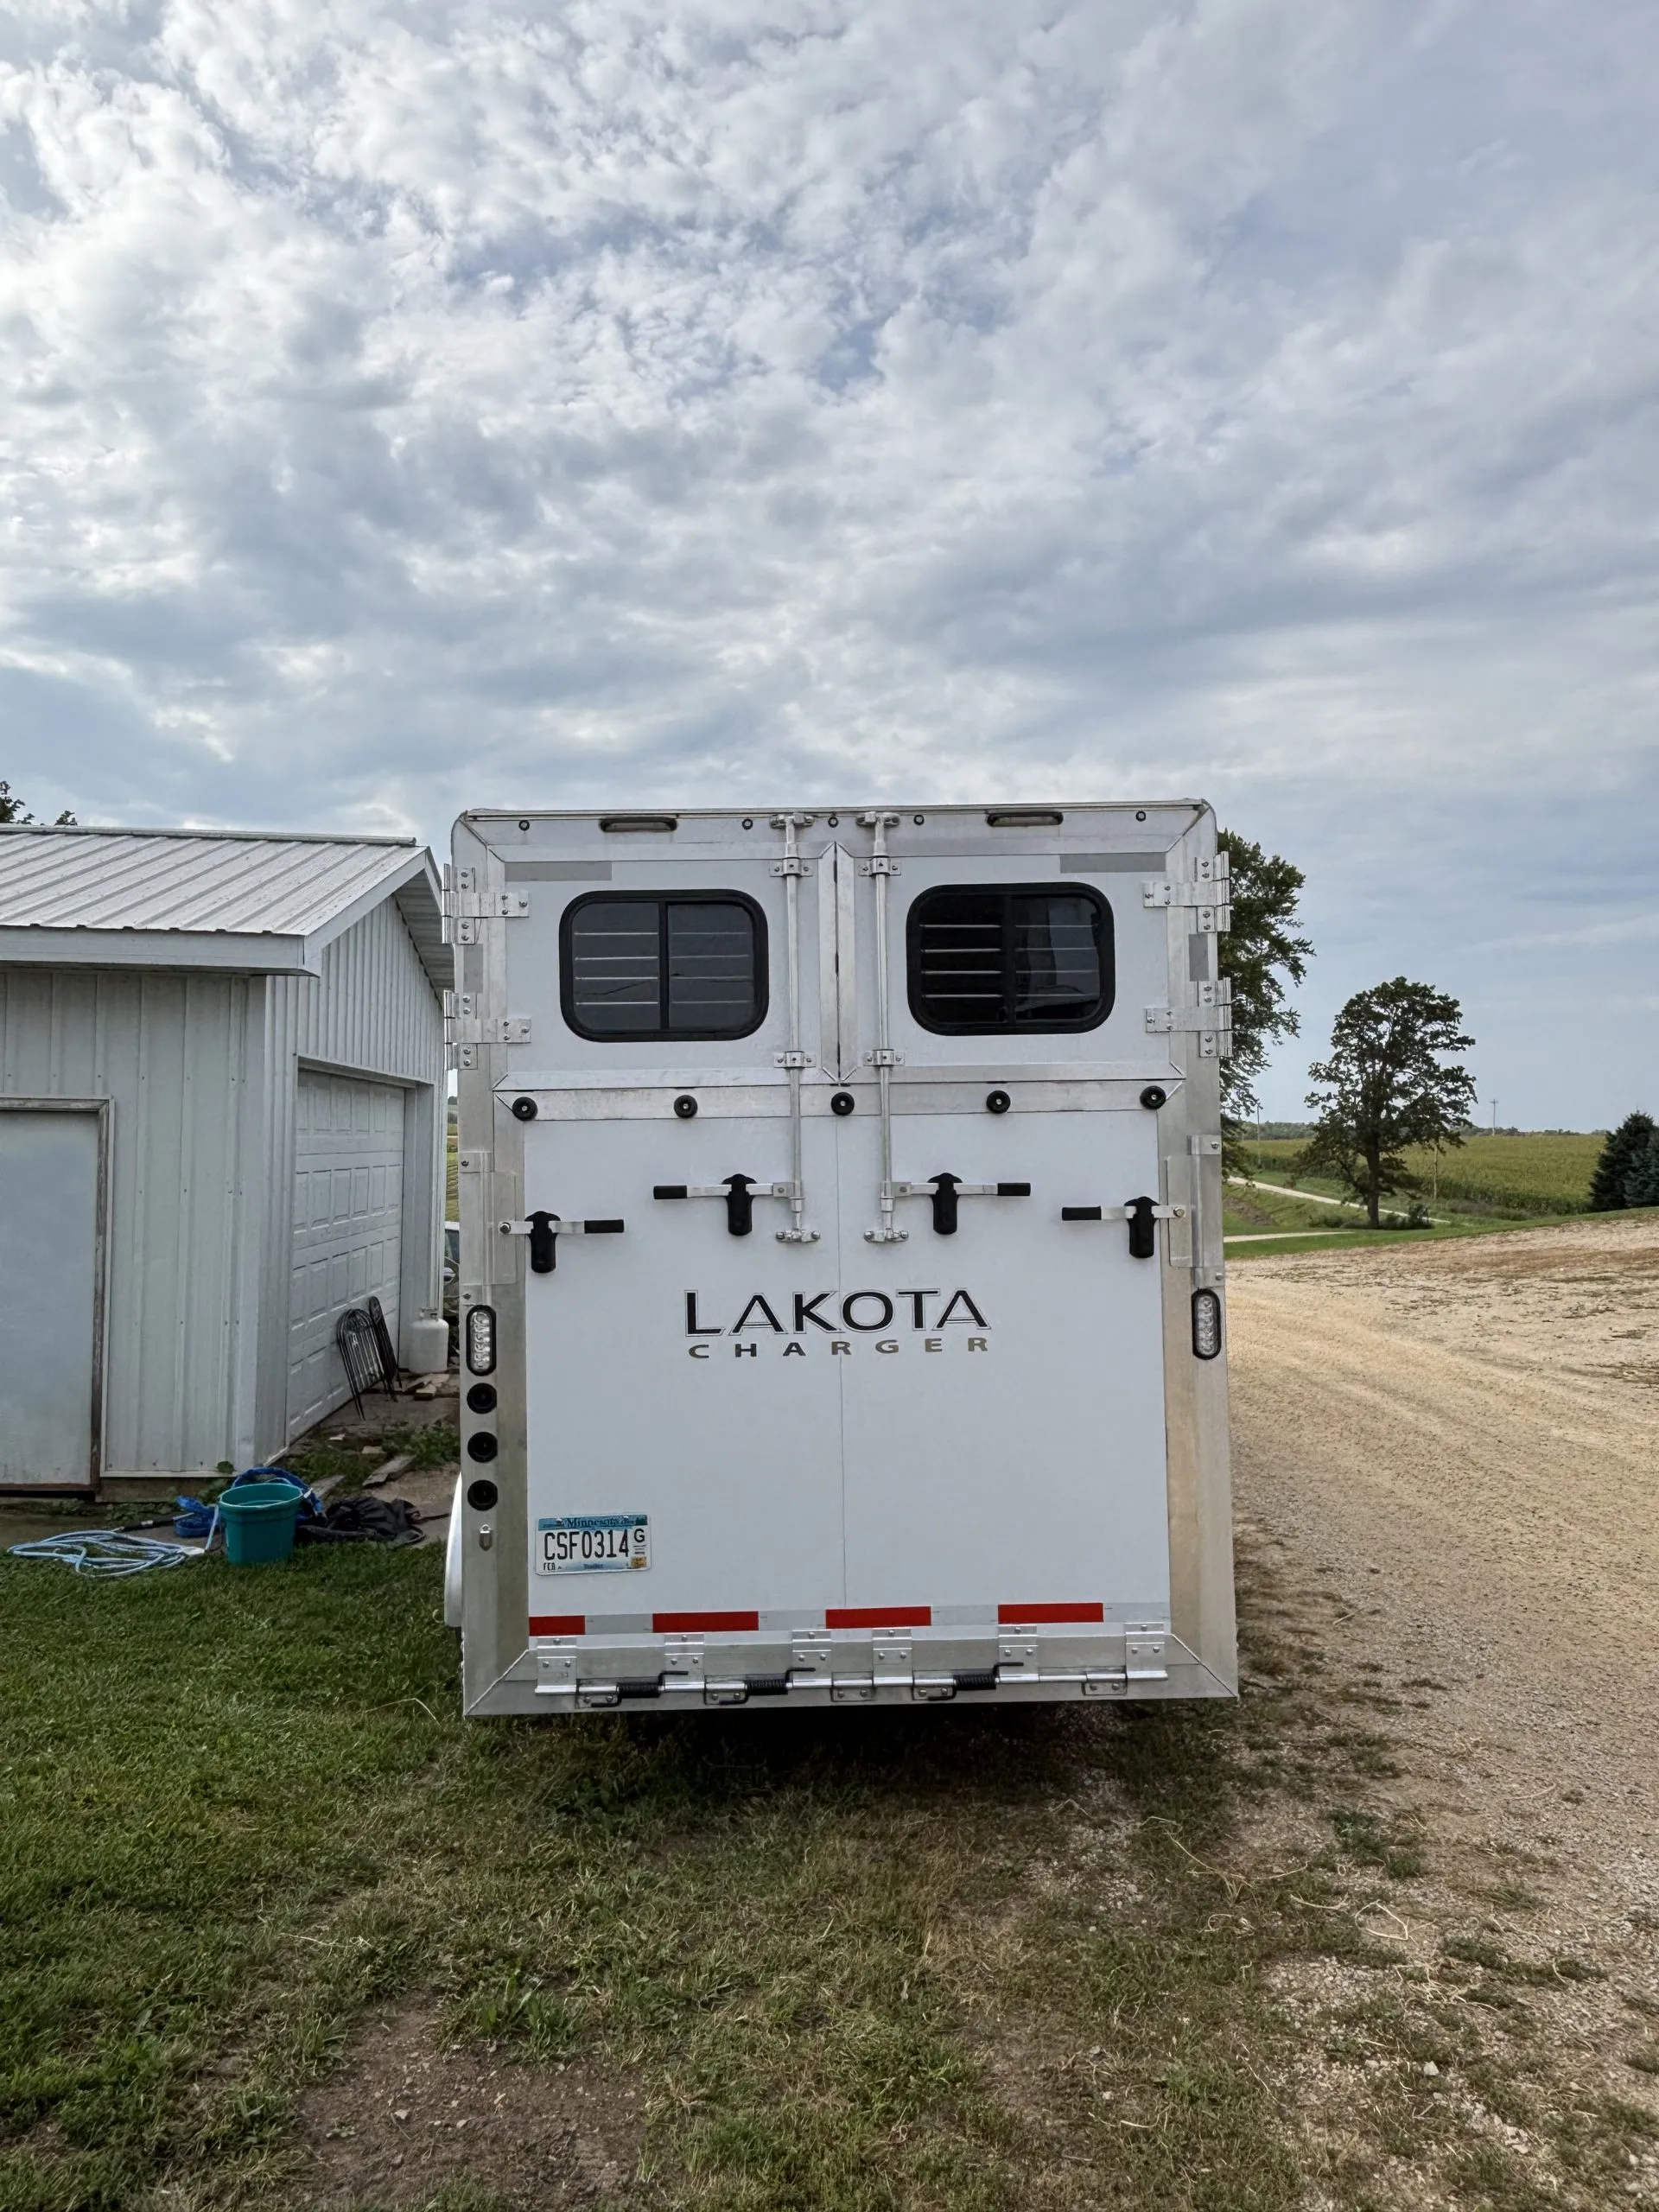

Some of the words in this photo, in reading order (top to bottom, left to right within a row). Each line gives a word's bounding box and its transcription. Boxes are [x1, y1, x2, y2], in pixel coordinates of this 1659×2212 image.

[684, 1287, 992, 1337] LAKOTA
[689, 1338, 988, 1359] CHARGER
[543, 1529, 629, 1560] CSF0314
[633, 1528, 645, 1543] G
